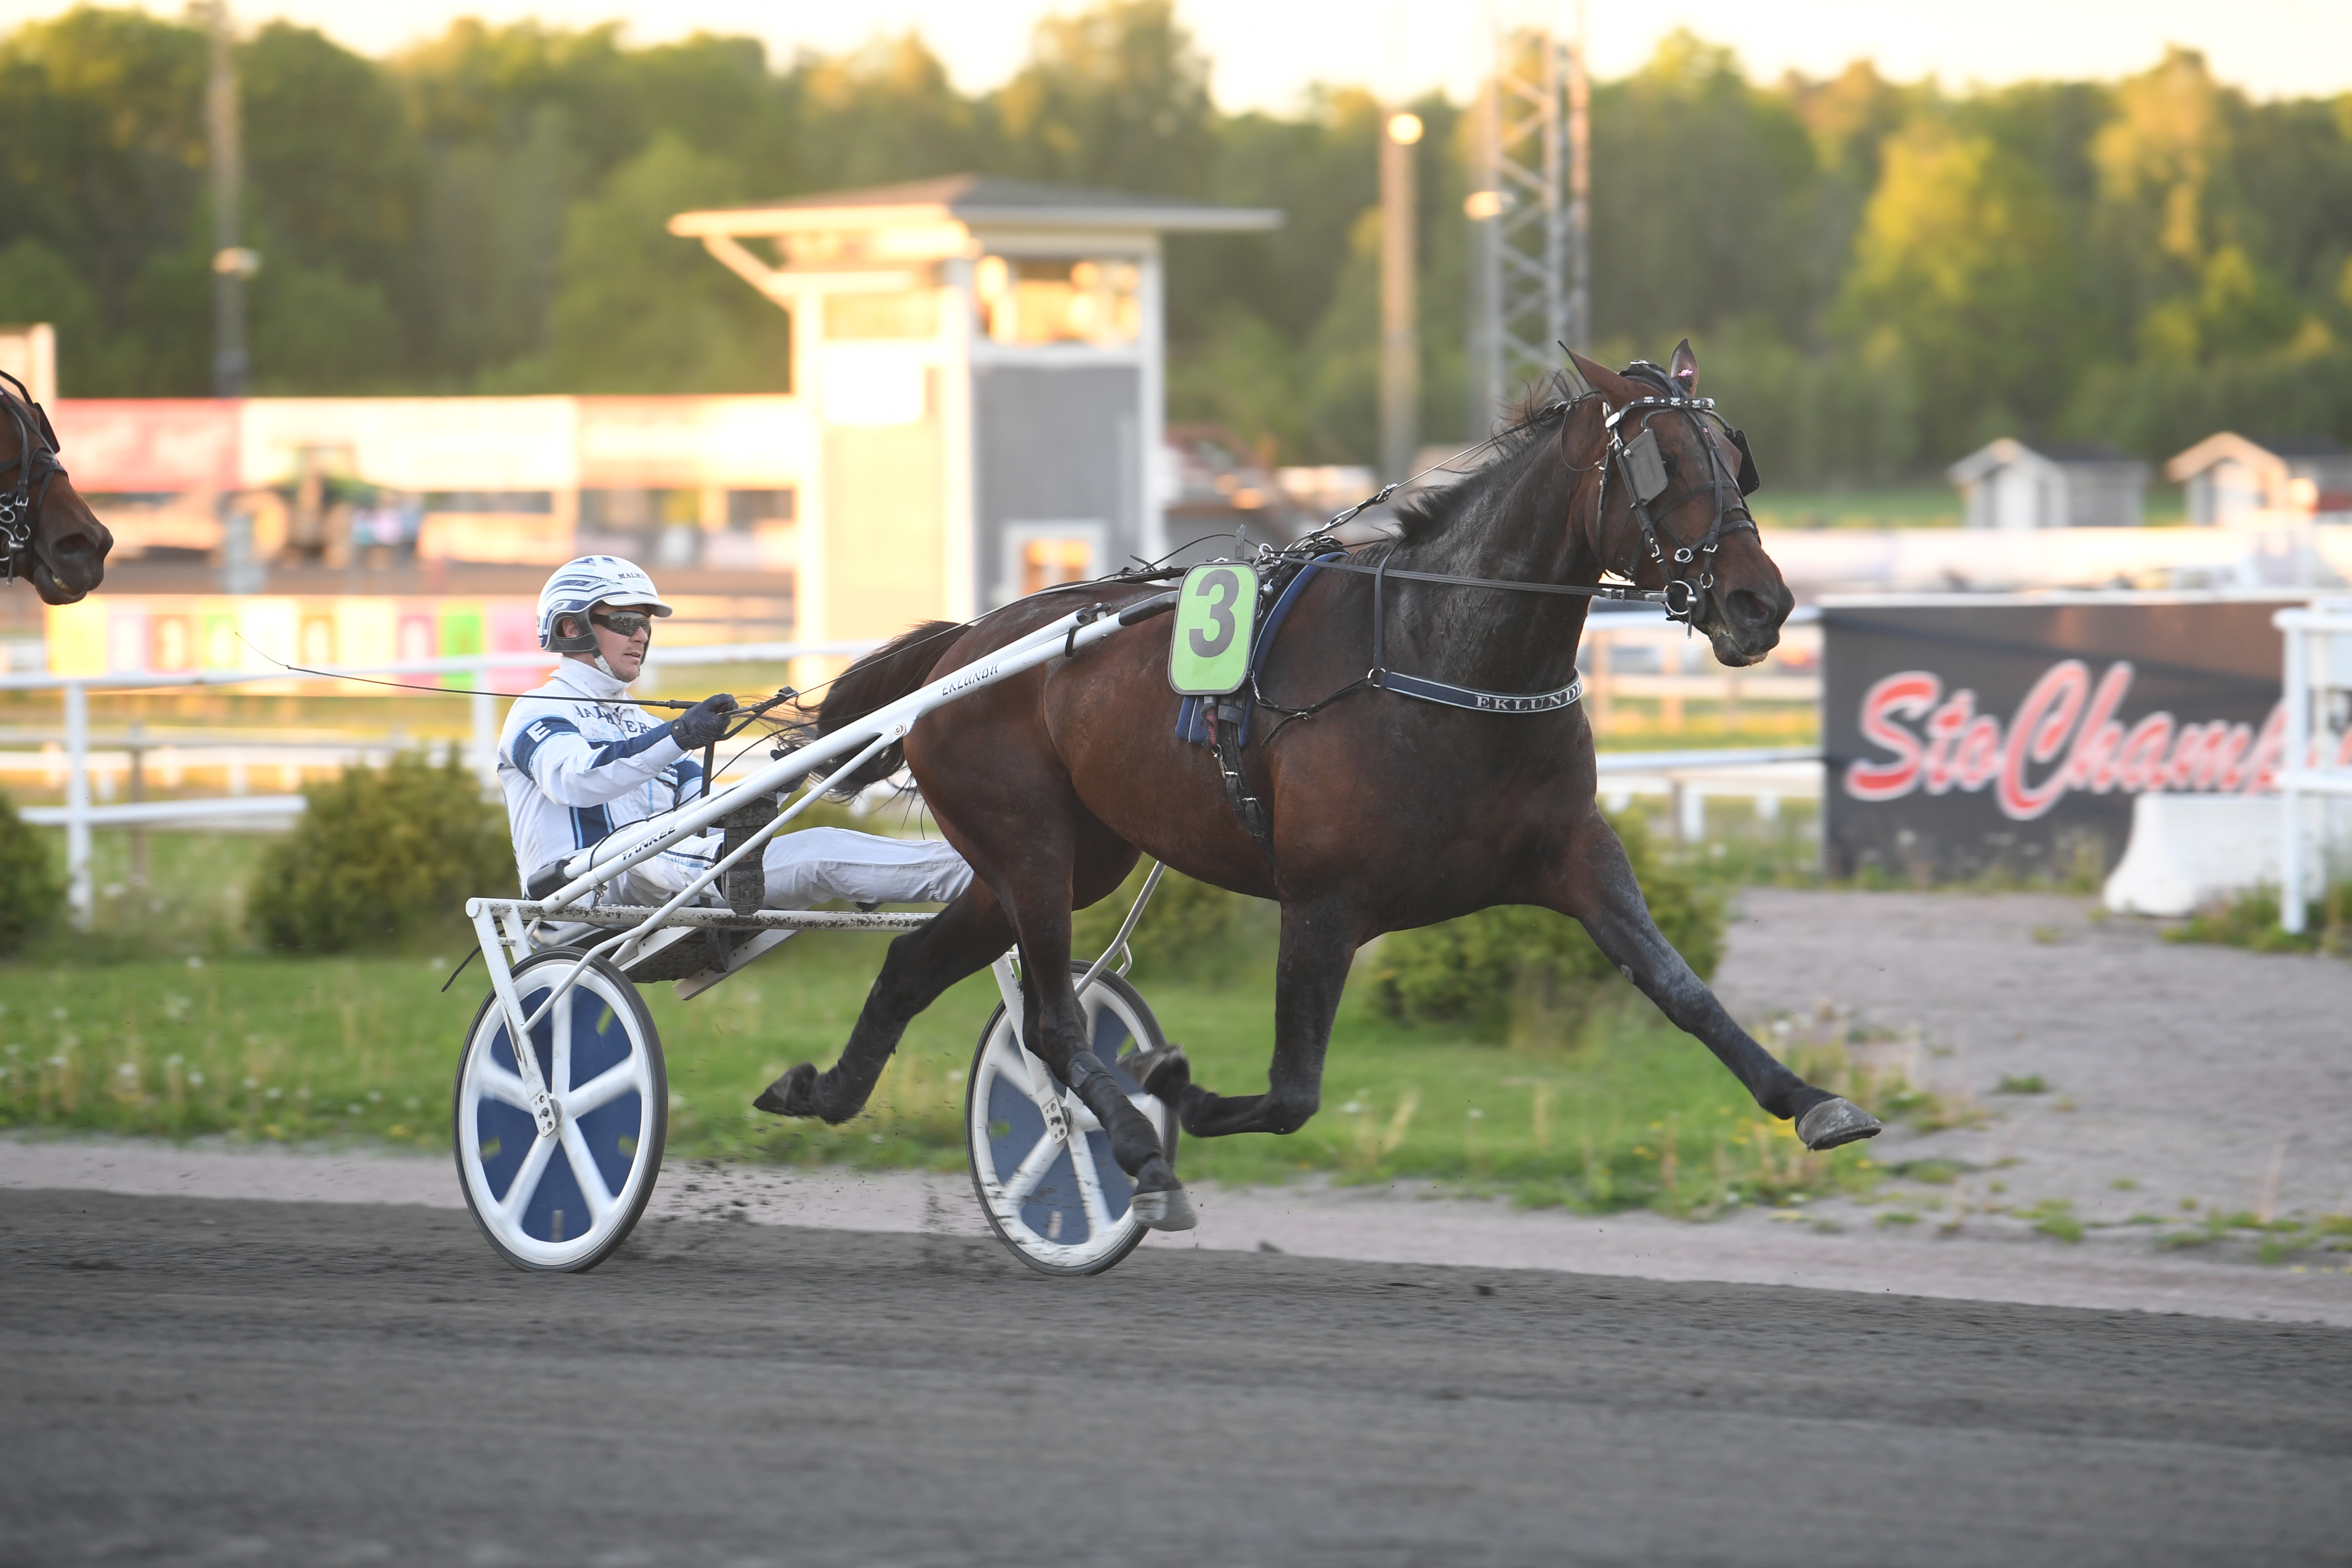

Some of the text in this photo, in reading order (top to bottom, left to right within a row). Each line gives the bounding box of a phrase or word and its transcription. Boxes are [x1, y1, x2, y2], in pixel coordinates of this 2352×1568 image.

[1189, 569, 1239, 658] 3
[942, 663, 999, 696] EKLUNDH
[1475, 681, 1582, 710] EKLUNDH
[622, 823, 677, 860] YANKEE
